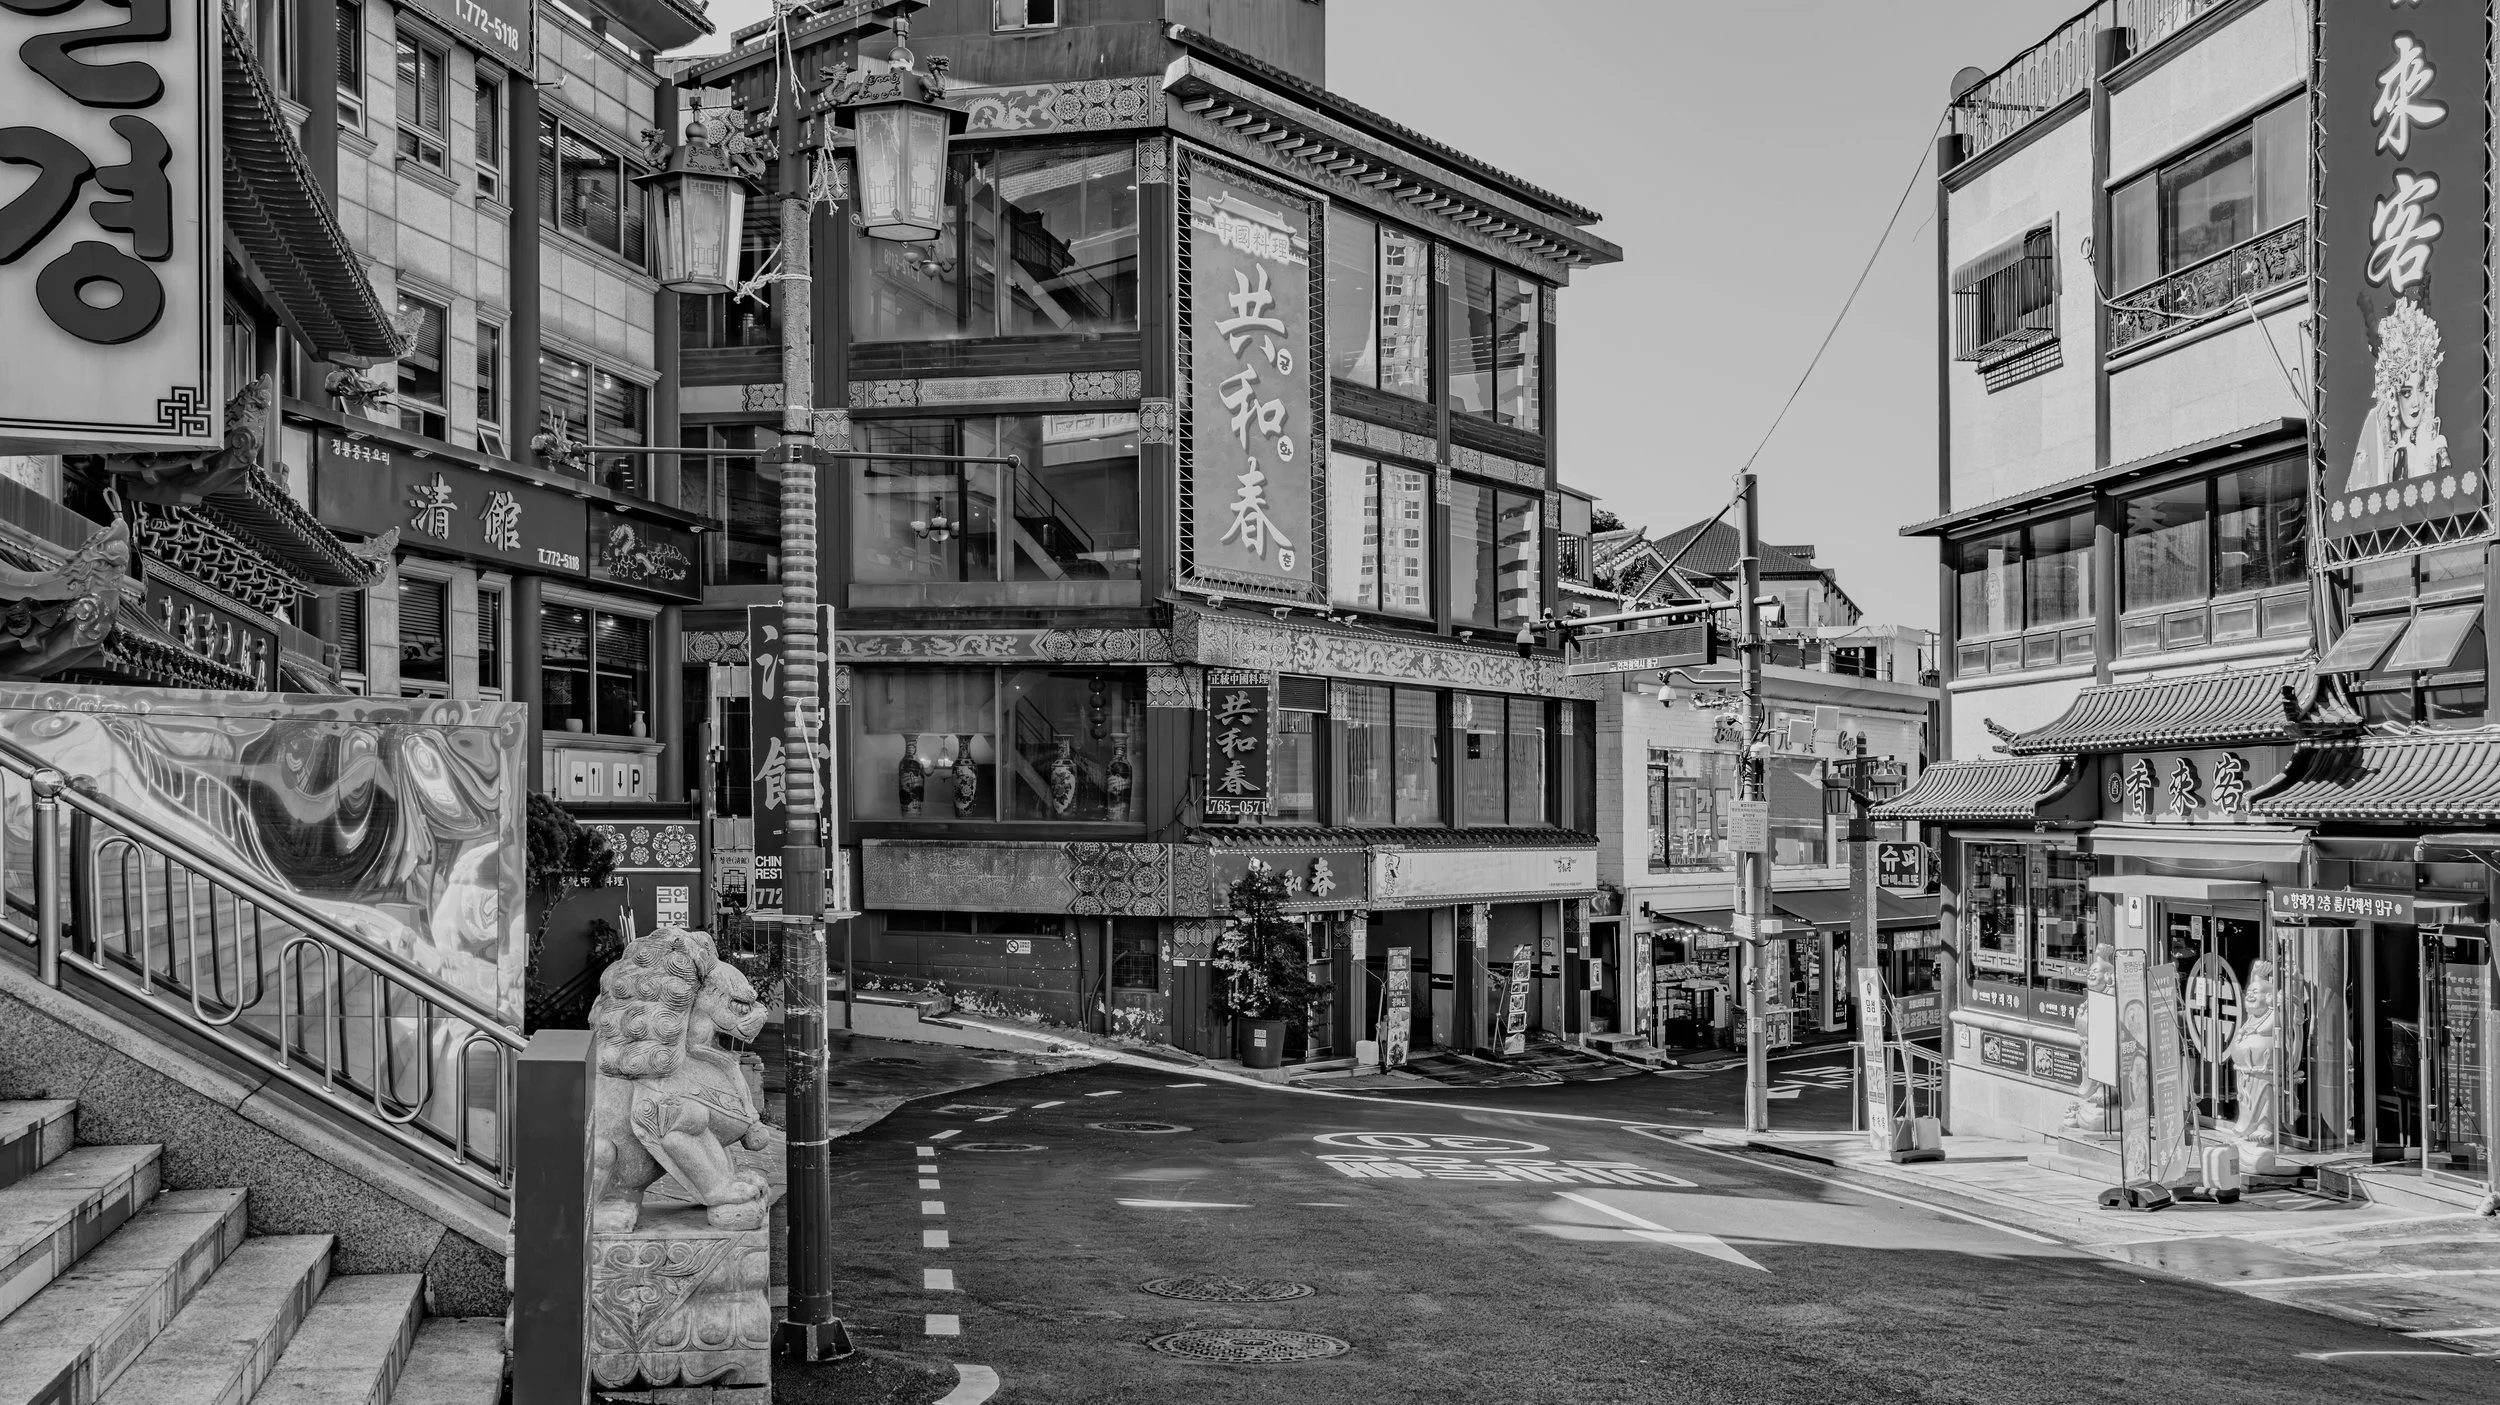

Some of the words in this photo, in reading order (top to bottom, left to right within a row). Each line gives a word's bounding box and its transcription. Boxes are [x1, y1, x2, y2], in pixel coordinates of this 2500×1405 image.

[1218, 216, 1289, 260] 中國料理
[1215, 262, 1293, 557] 共和春
[330, 438, 390, 466] 정통중국요리
[537, 548, 580, 571] T.772-5118
[1617, 658, 1645, 671] 인천광역시
[1646, 657, 1659, 668] 중구
[1211, 672, 1269, 686] 正統中國料理
[1214, 690, 1264, 796] 共和春
[632, 769, 641, 794] P
[2125, 751, 2245, 816] 香來客
[1210, 800, 1266, 814] 765-0571
[1880, 845, 1919, 873] 슈퍼
[657, 888, 688, 904] 금연
[2290, 892, 2315, 910] 향래객
[2317, 895, 2332, 912] 2층
[2333, 896, 2373, 915] 룸/단체석
[2374, 899, 2394, 917] 입구
[657, 911, 688, 927] 구역
[2060, 1004, 2075, 1019] 향래
[1356, 1134, 1511, 1150] 30
